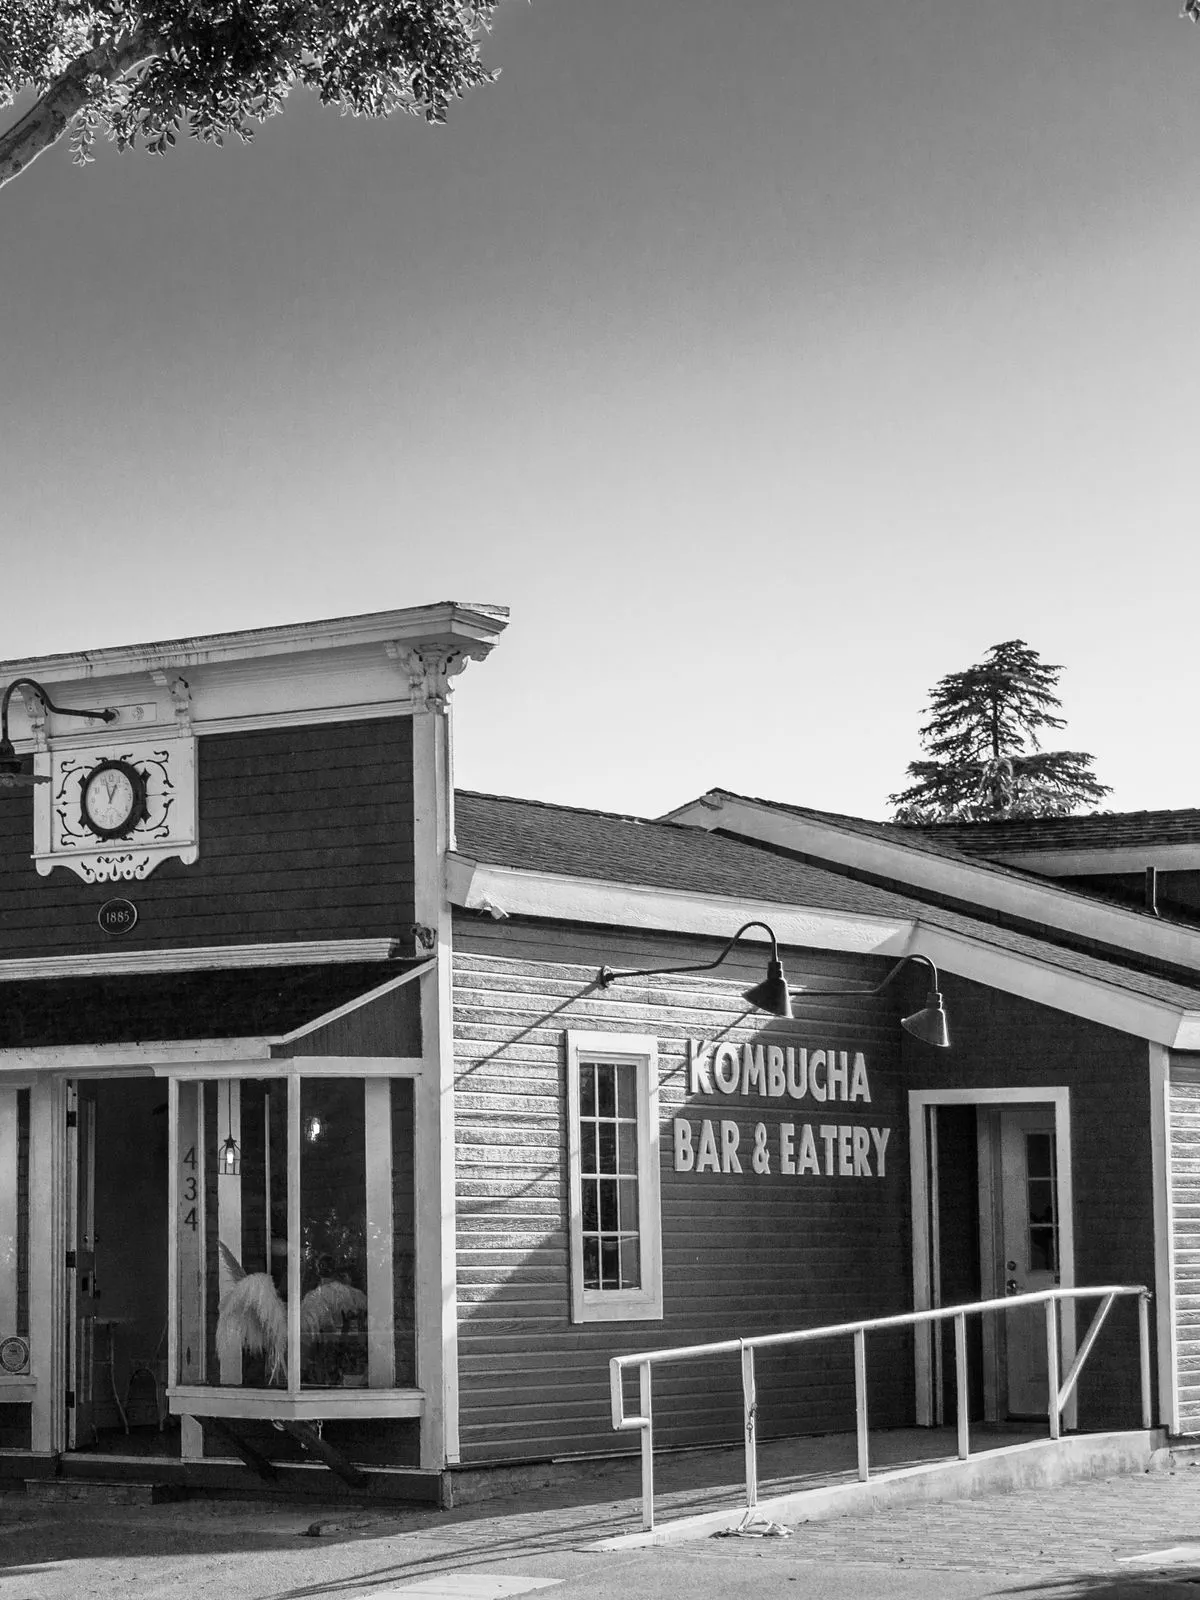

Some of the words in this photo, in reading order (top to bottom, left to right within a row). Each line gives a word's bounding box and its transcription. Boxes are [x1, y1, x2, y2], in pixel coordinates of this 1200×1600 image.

[106, 910, 130, 923] 1885
[689, 1039, 872, 1103] KOMBUCHA
[673, 1117, 744, 1174] BAR
[752, 1121, 771, 1175] &
[779, 1122, 891, 1177] EATERY
[183, 1146, 198, 1231] 434
